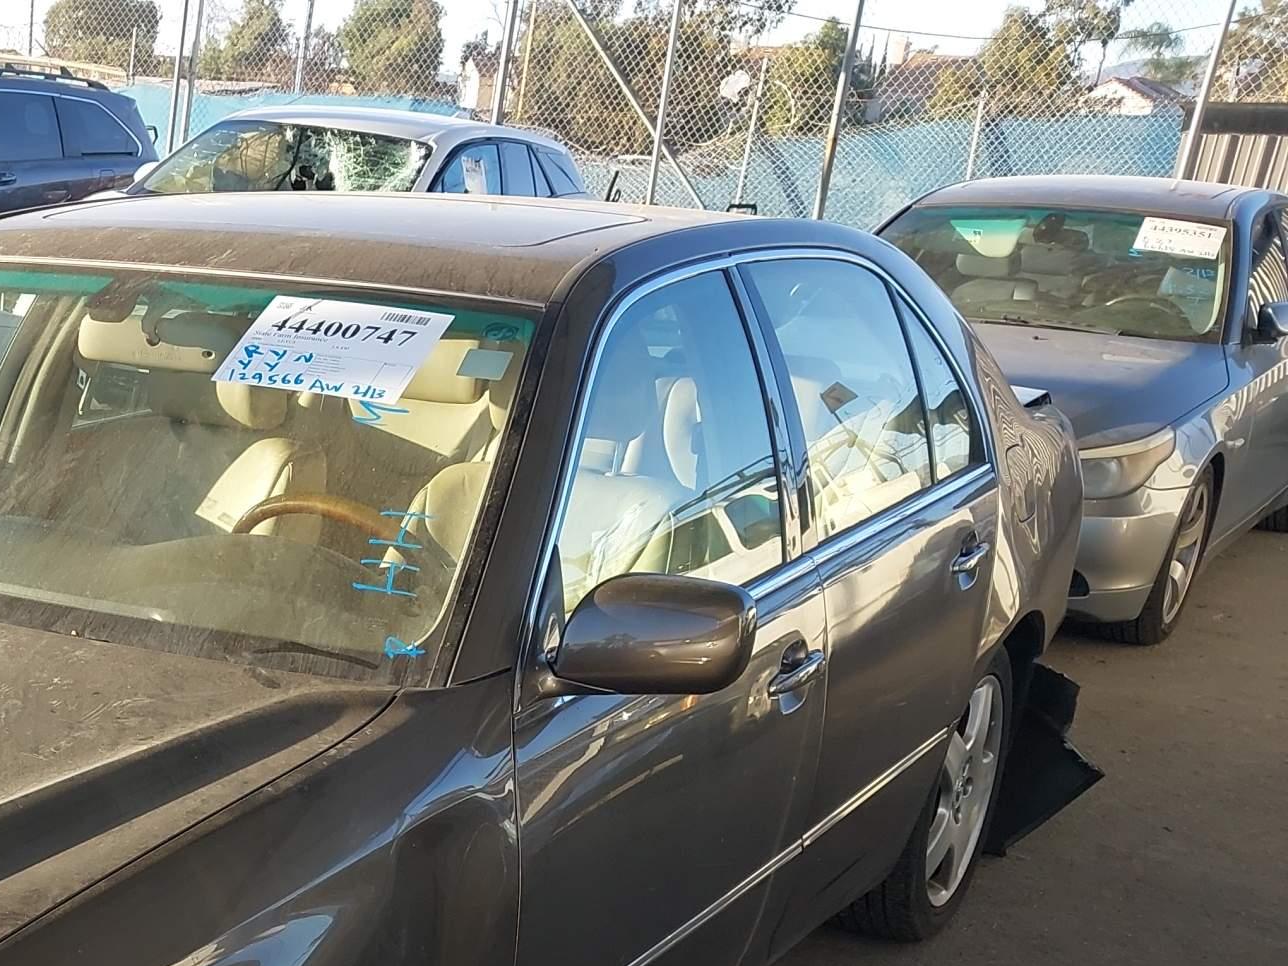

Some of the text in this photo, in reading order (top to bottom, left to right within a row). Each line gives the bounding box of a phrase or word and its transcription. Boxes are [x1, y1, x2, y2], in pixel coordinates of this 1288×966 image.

[271, 316, 418, 347] 44400747
[228, 368, 387, 399] 129566 AW 2/13
